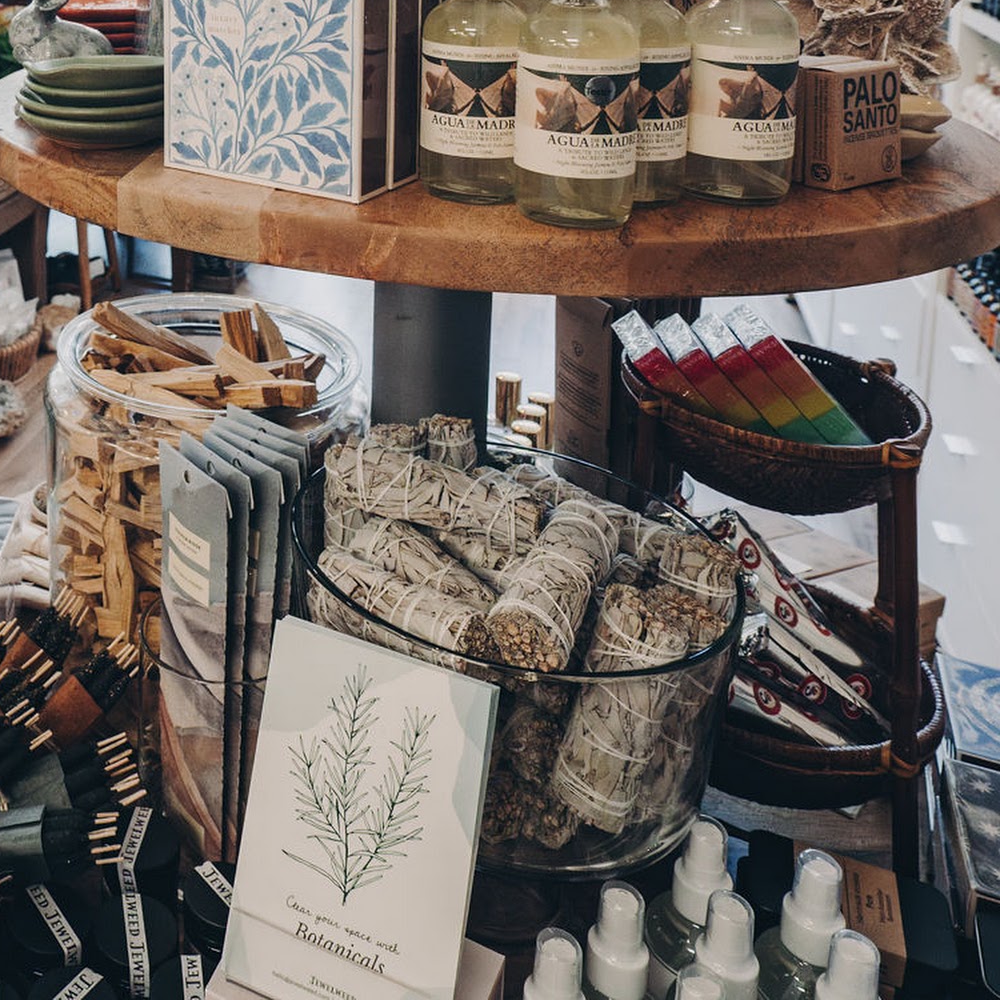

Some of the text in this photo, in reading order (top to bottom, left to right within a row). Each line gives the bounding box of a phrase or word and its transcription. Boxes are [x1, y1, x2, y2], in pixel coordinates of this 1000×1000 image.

[843, 71, 898, 110] PALO
[431, 114, 465, 129] AGUA
[732, 121, 773, 133] AGUA
[843, 103, 898, 133] SANTO
[547, 134, 589, 148] AGUA
[286, 894, 313, 917] Clear
[315, 914, 341, 929] your
[294, 921, 386, 975] Botanicals
